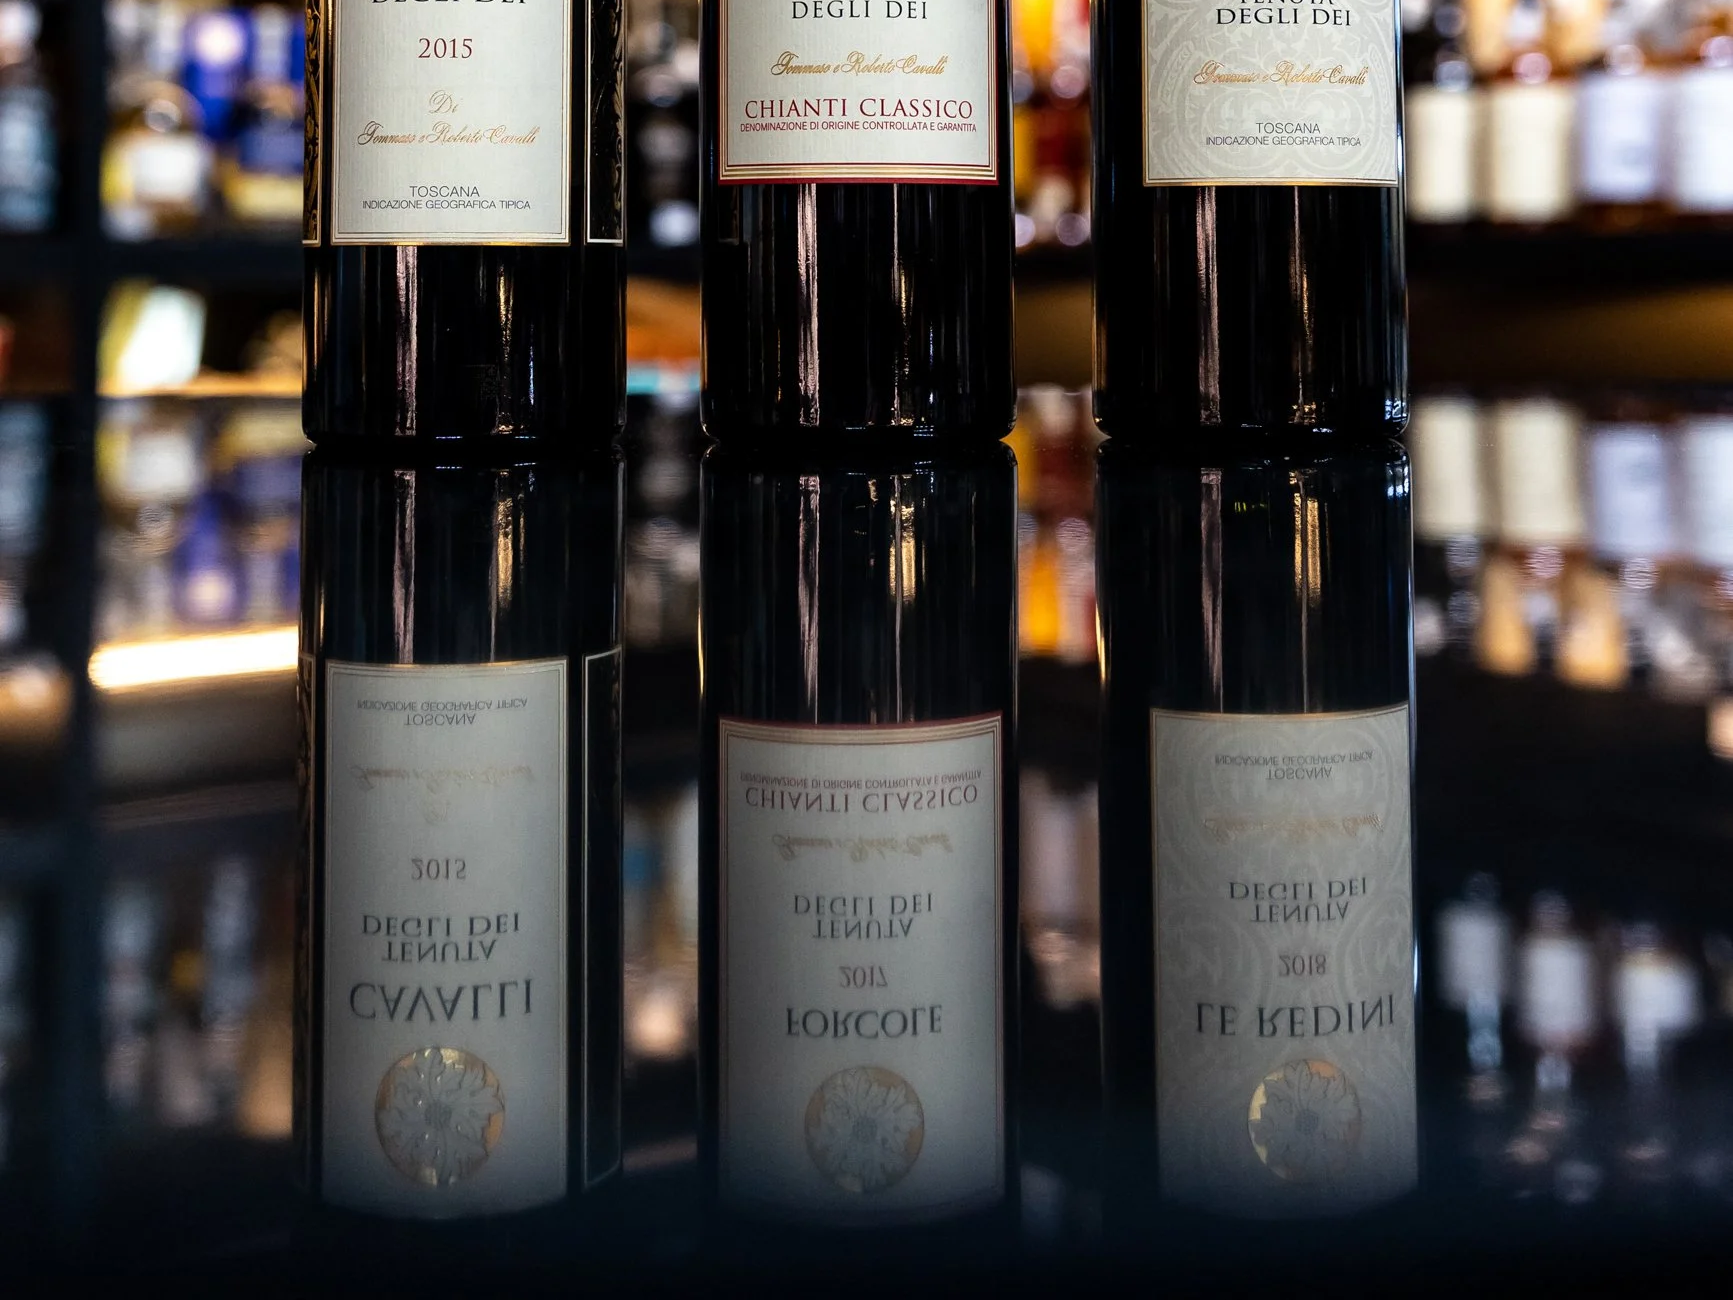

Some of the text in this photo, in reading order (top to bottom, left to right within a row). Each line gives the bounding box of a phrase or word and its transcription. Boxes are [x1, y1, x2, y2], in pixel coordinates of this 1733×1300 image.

[792, 0, 928, 20] DEGLI DEI
[1216, 7, 1351, 26] DEGLI DEI
[418, 37, 473, 59] 2015
[840, 50, 895, 77] Roberto
[895, 54, 948, 76] Cavalli
[1322, 64, 1369, 85] Cavalli
[745, 98, 973, 119] CHIANTI CLASSICO
[426, 120, 482, 146] Roberto
[482, 124, 540, 145] Cavalli
[740, 120, 977, 133] DENOMINAZIONE DI ORIGINE CONTROLLATA E GARANTITA
[1255, 122, 1321, 134] TOSCANA
[1206, 136, 1361, 147] INDICAZIONE GEOGRAFICA TIPICA
[409, 185, 480, 198] TOSCANA
[362, 199, 531, 210] INDICAZIONE GEOGRAFICA TIPICA
